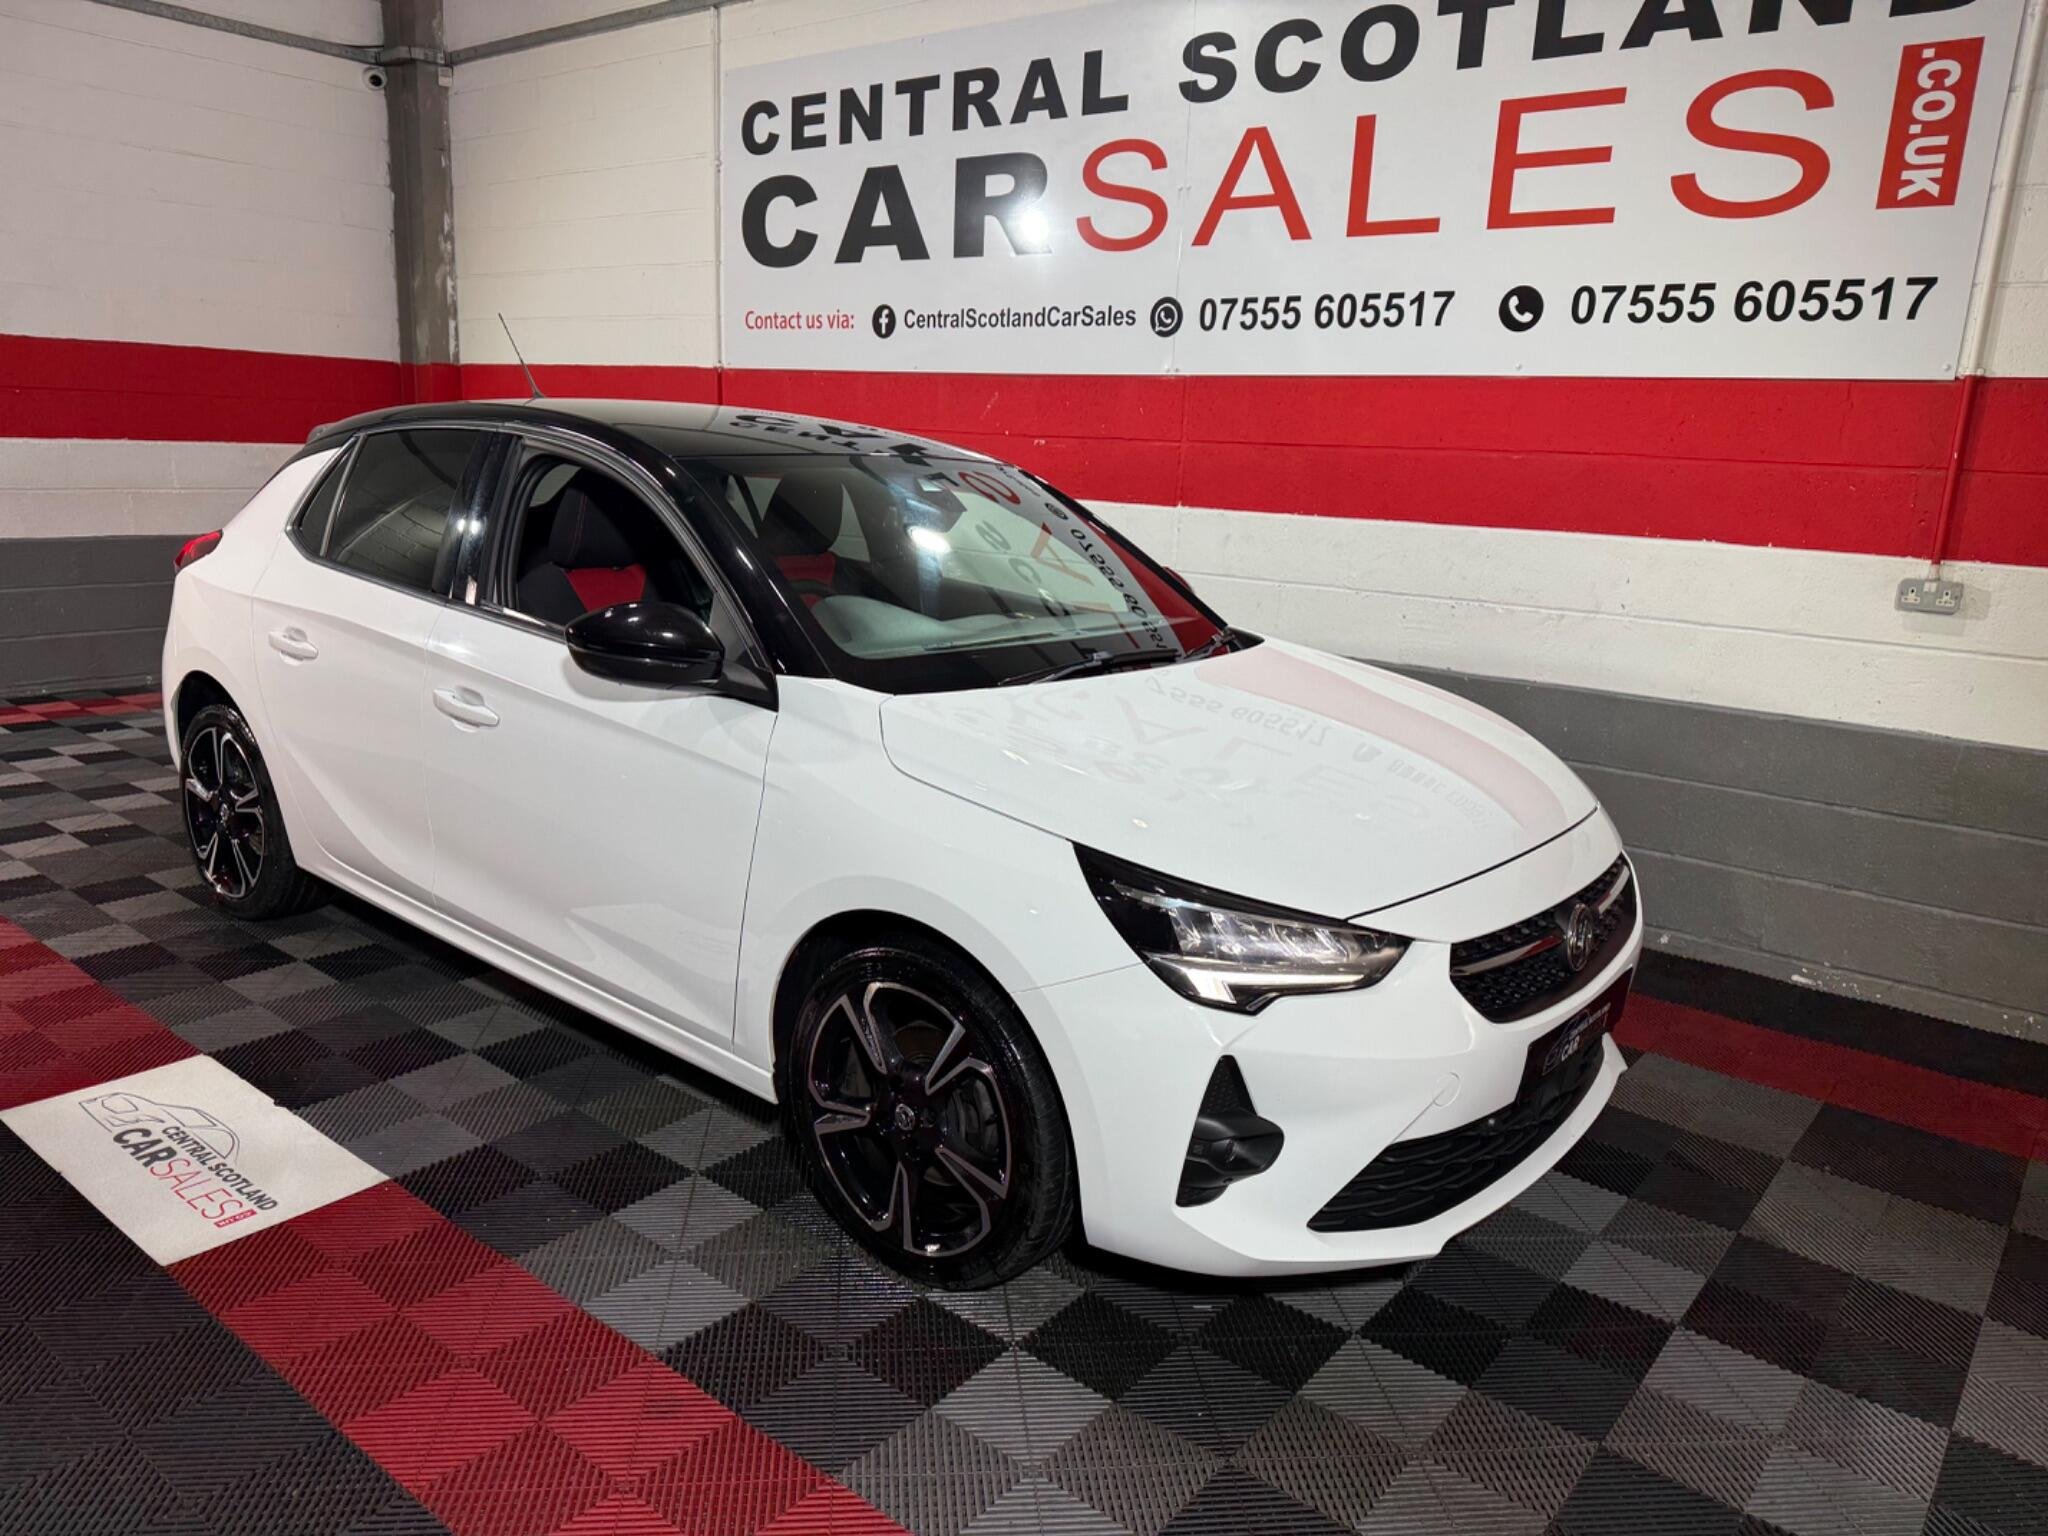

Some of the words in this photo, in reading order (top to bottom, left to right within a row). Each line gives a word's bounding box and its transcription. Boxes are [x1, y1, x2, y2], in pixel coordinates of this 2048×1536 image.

[742, 50, 1130, 155] CENTRAL
[1178, 0, 1977, 103] SCOTLA
[745, 310, 802, 330] Contact
[806, 314, 823, 329] us
[827, 309, 855, 329] via:
[903, 305, 1137, 330] CentralScotlandCarSales
[1199, 295, 1302, 331] 07555
[1314, 291, 1456, 329] 605517
[1571, 283, 1717, 325] 07555
[1733, 277, 1939, 323] 605517
[162, 1126, 218, 1166] CENTRAL
[208, 1162, 279, 1211] SCOTLAND
